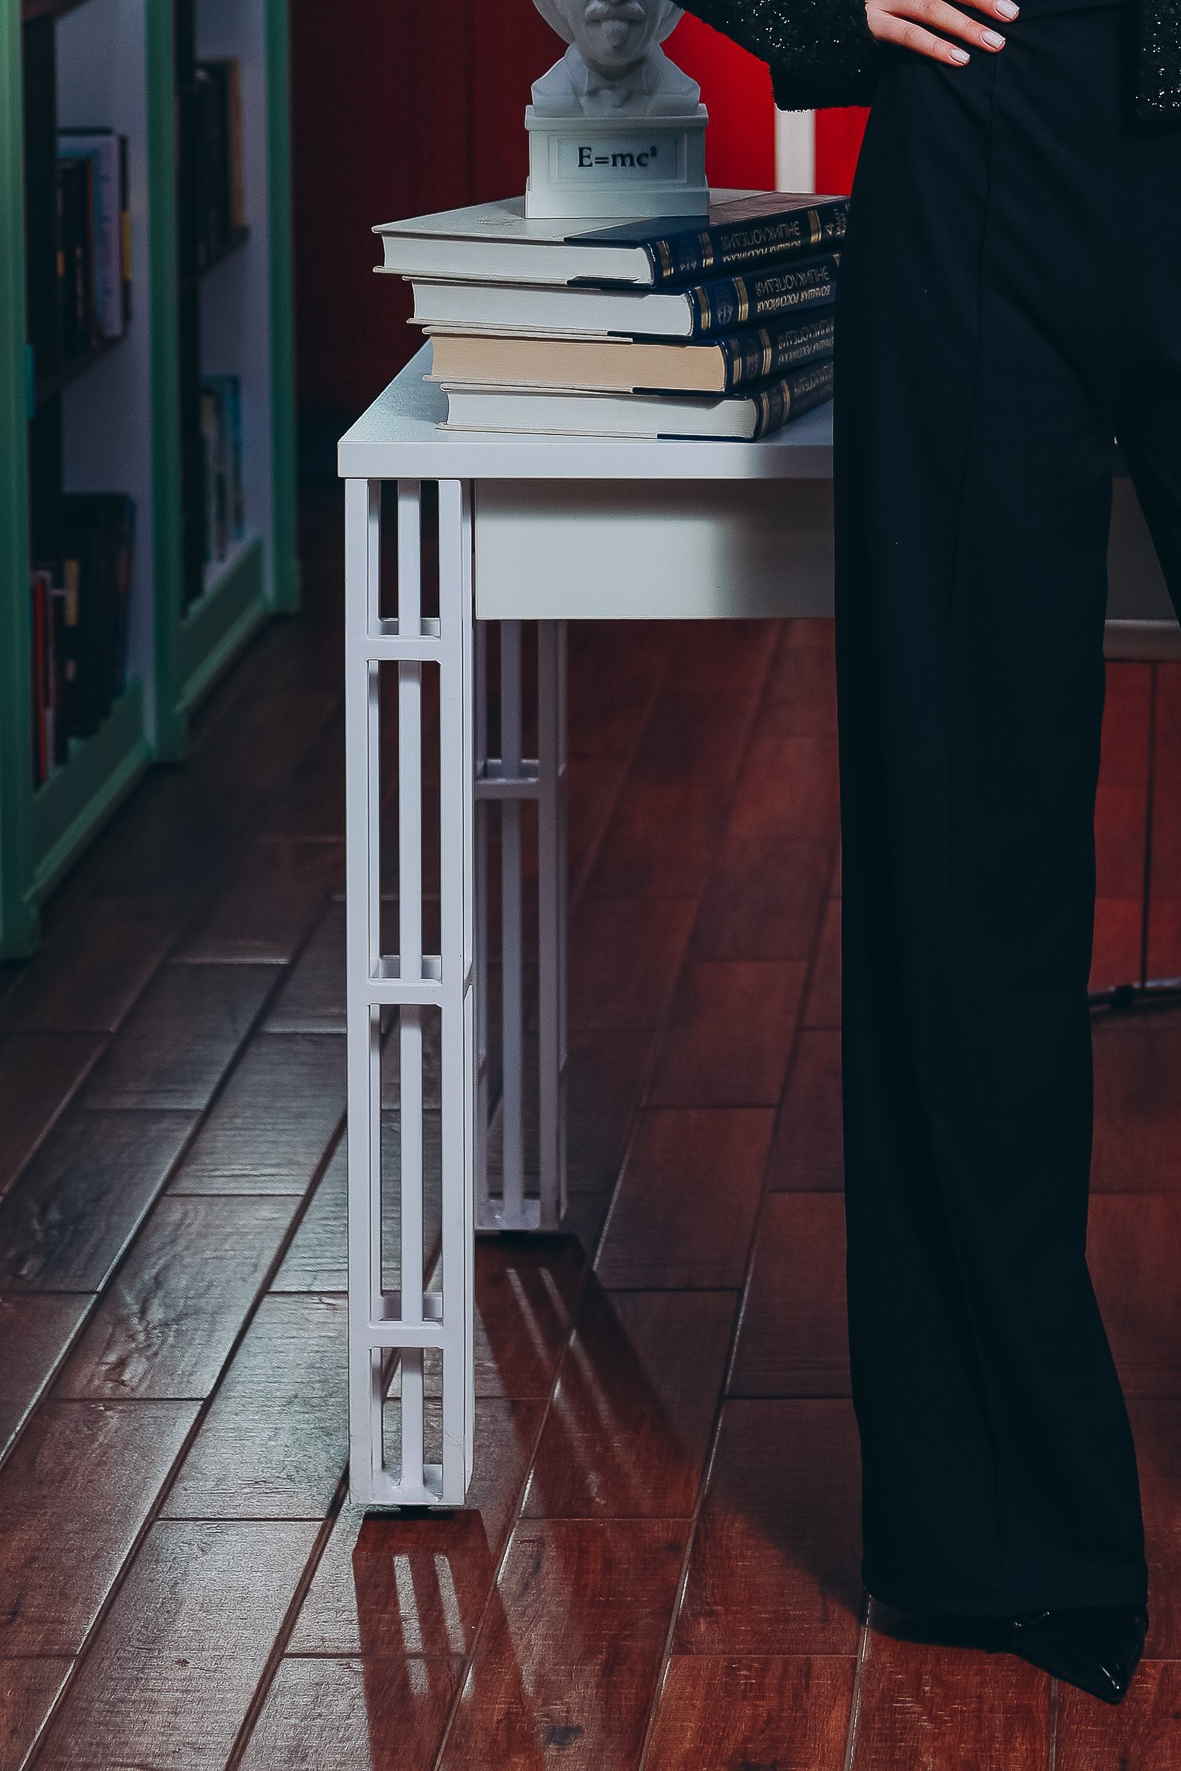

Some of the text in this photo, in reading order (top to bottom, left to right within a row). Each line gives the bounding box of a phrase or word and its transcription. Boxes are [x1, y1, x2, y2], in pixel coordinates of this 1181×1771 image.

[719, 220, 800, 249] ЭНЦИКЛОПЕДИЯ
[754, 265, 830, 297] ЭНЦИКЛОПЕДИЯ
[756, 284, 831, 313] БОЛЬШАЯ РОССИЙСКАЯ
